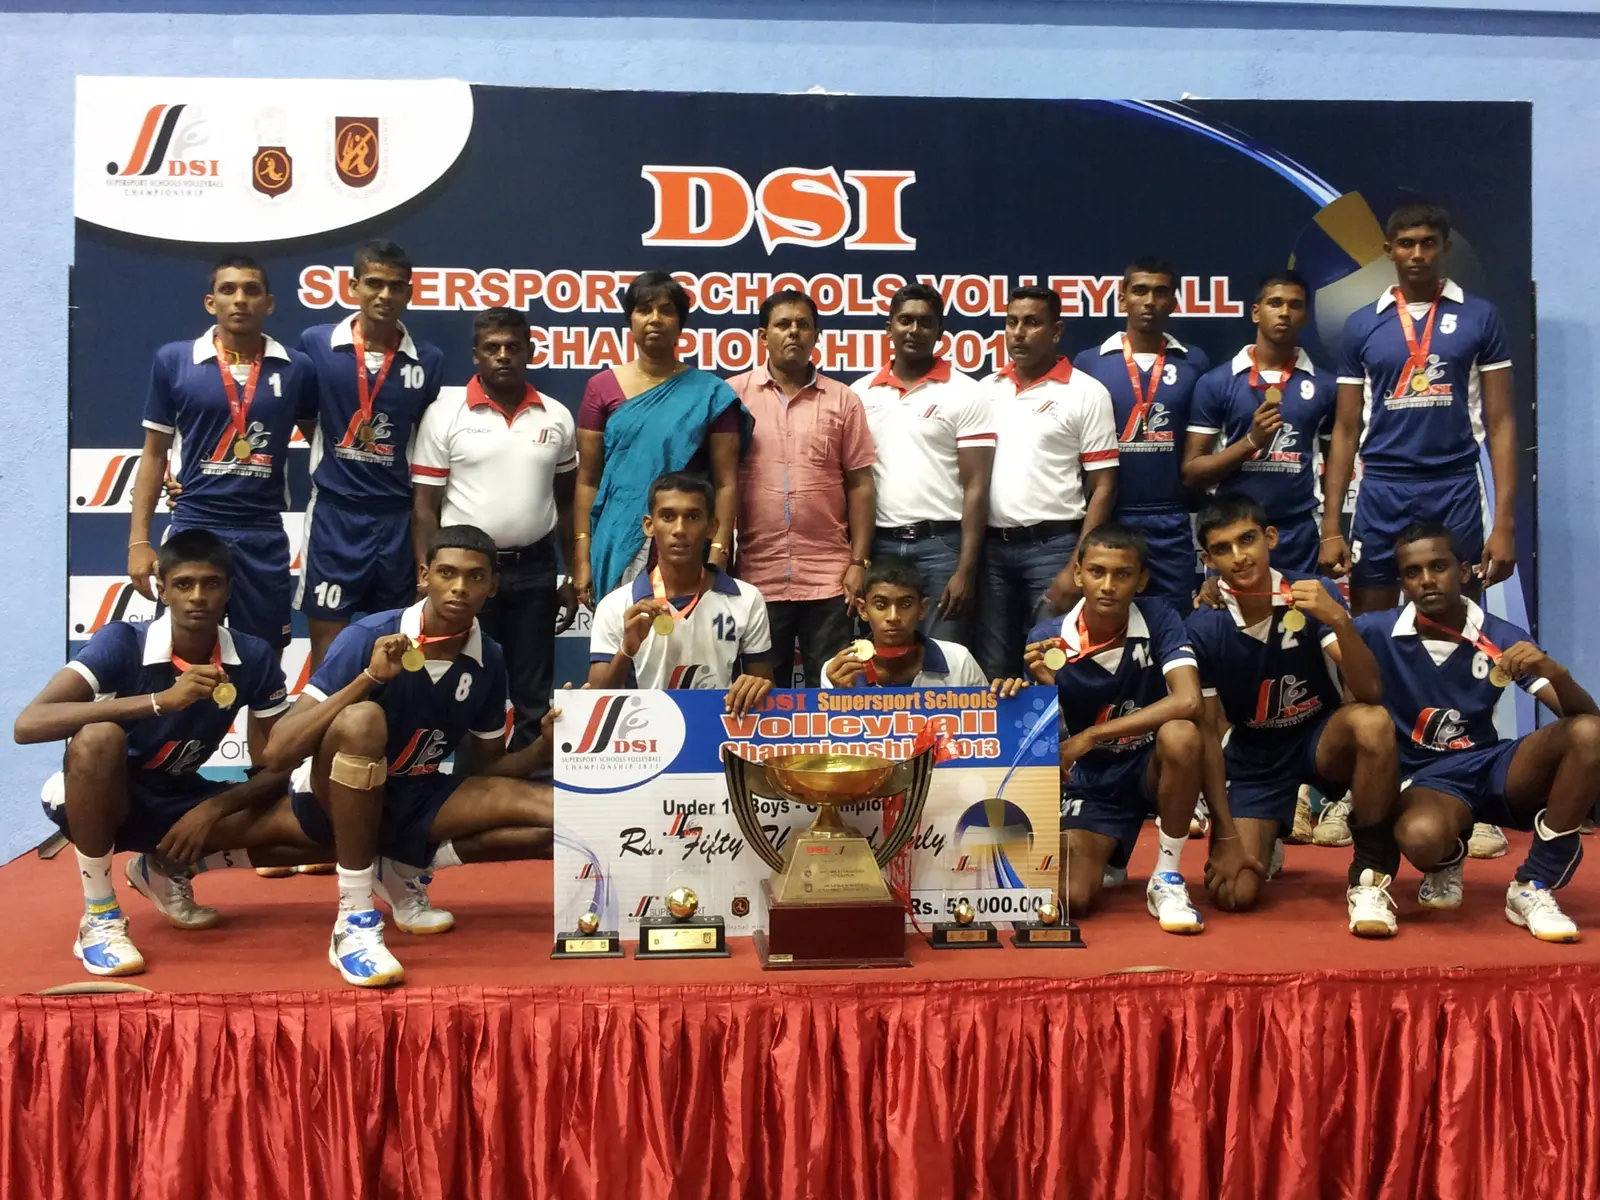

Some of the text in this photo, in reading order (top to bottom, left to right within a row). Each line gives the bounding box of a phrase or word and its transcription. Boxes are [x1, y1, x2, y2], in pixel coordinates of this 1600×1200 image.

[168, 159, 220, 176] DSI
[641, 165, 917, 256] DSI
[298, 265, 647, 313] SUERSPOR
[916, 274, 1244, 318] VOLEYLL
[1439, 313, 1458, 335] 5
[935, 329, 1009, 372] 201
[268, 372, 282, 397] 1
[400, 363, 425, 390] 10
[1162, 363, 1178, 386] 3
[1300, 379, 1315, 401] 9
[1351, 540, 1362, 564] 5
[314, 581, 342, 609] 10
[712, 611, 736, 642] 12
[1472, 652, 1489, 679] 6
[454, 672, 473, 702] 8
[755, 690, 997, 713] DSI Supersport Schools
[720, 709, 997, 739] Volleyball
[599, 755, 626, 763] SCHOOLS
[627, 755, 661, 763] VOLLEYBALL
[613, 739, 658, 753] DSI
[719, 737, 1000, 764] Championshi 013
[663, 798, 715, 815] Under
[752, 799, 789, 818] Boys
[619, 827, 664, 857] Rs.
[682, 826, 745, 863] Fifty
[911, 895, 1043, 915] Rs. 5000.00
